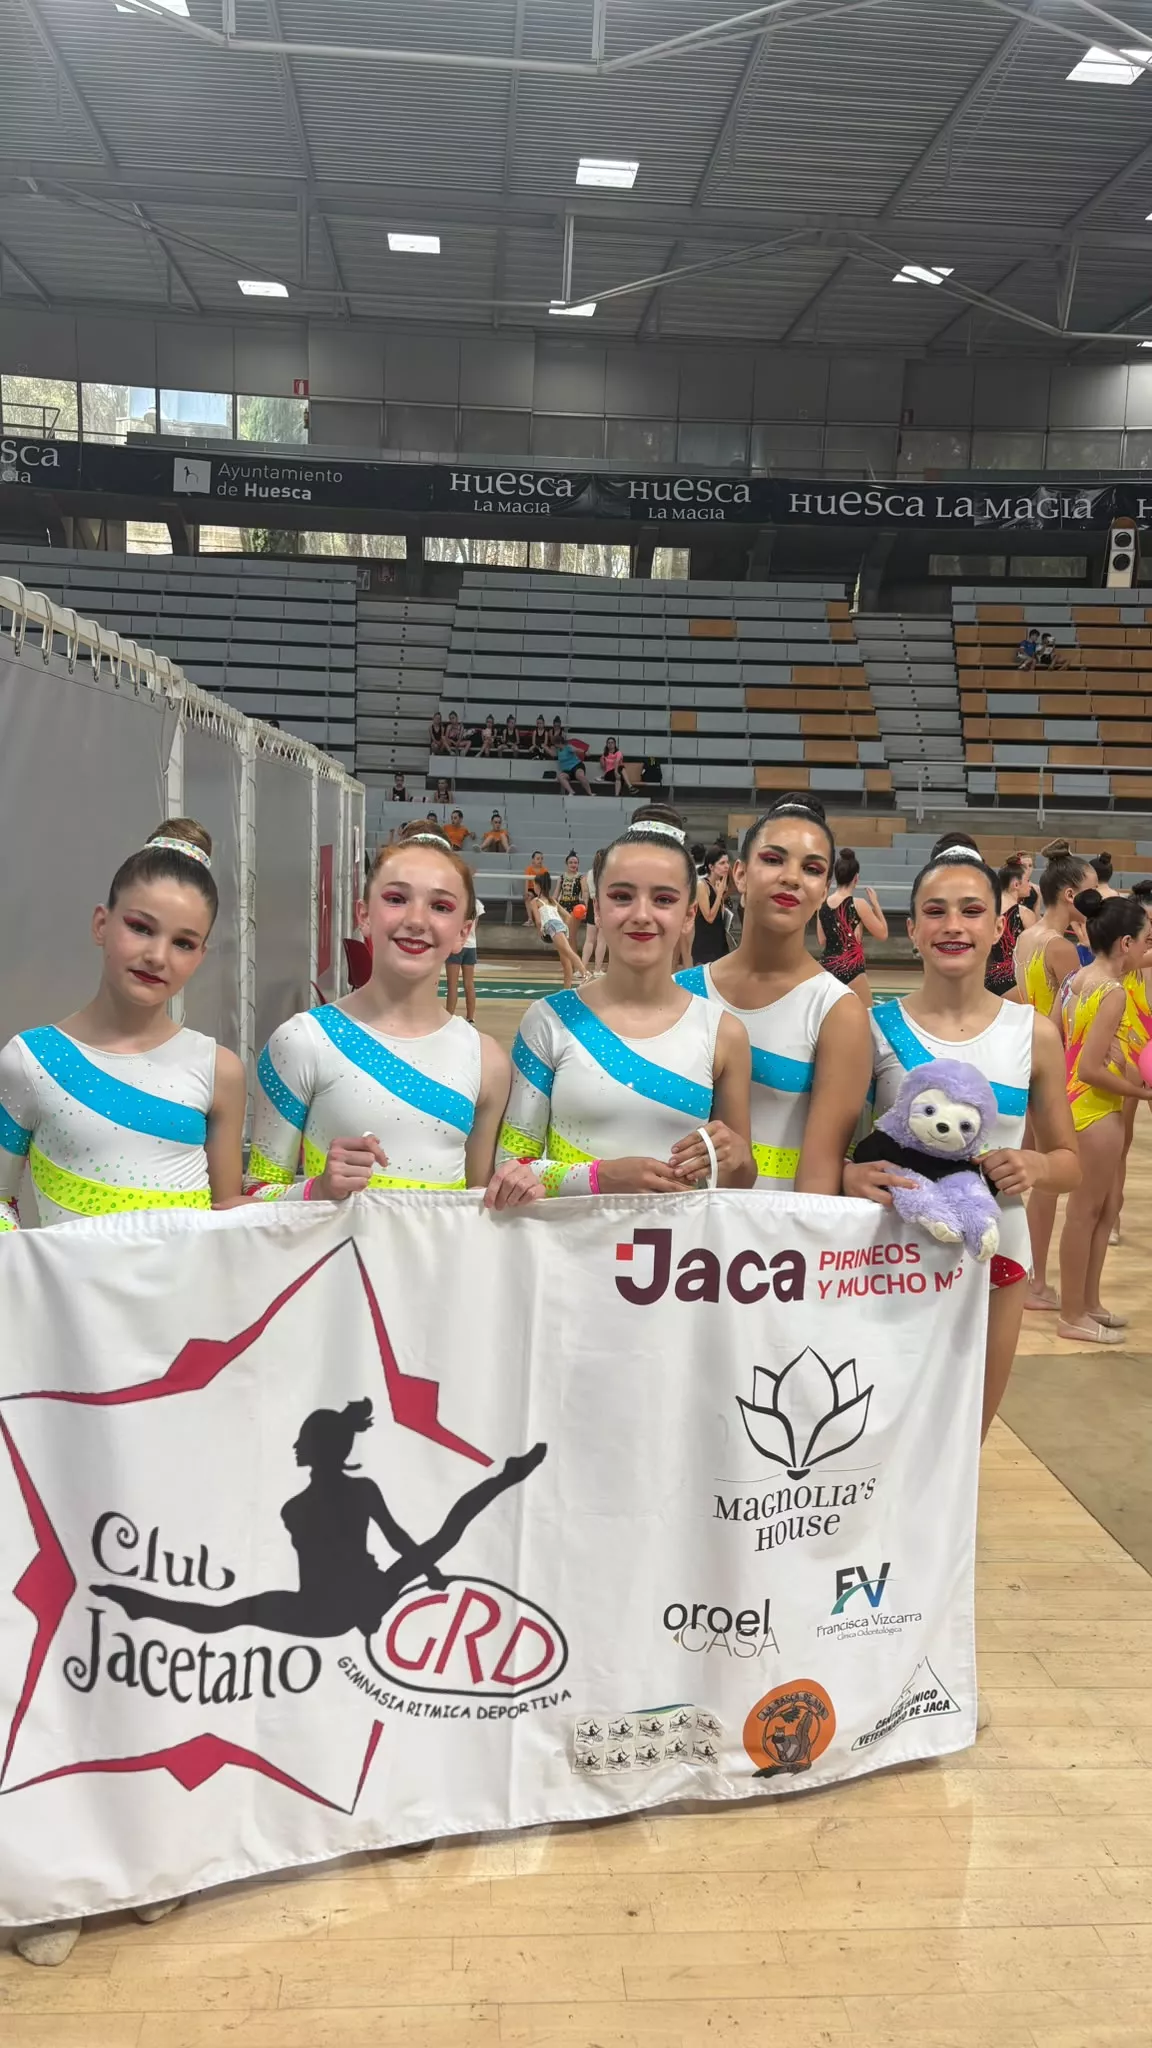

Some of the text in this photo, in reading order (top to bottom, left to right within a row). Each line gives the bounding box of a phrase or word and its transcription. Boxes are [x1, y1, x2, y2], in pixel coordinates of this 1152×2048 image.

[217, 481, 312, 500] de Huesca
[218, 462, 343, 483] Ayuntamiento
[615, 1228, 807, 1306] Jaca
[818, 1243, 921, 1271] PIRINEOS
[817, 1279, 833, 1299] Y
[837, 1272, 927, 1298] MUCHO
[91, 1511, 235, 1592] Club
[831, 1562, 891, 1615] FV
[663, 1598, 770, 1637] oroel
[816, 1618, 869, 1638] Francisca
[385, 1588, 556, 1686] GRD
[681, 1622, 780, 1658] CASA
[62, 1607, 323, 1706] Jacetano
[337, 1655, 572, 1720] GIMNASIA RITMICA DEPORTIVA
[909, 1705, 921, 1717] DE
[923, 1700, 951, 1713] JACA
